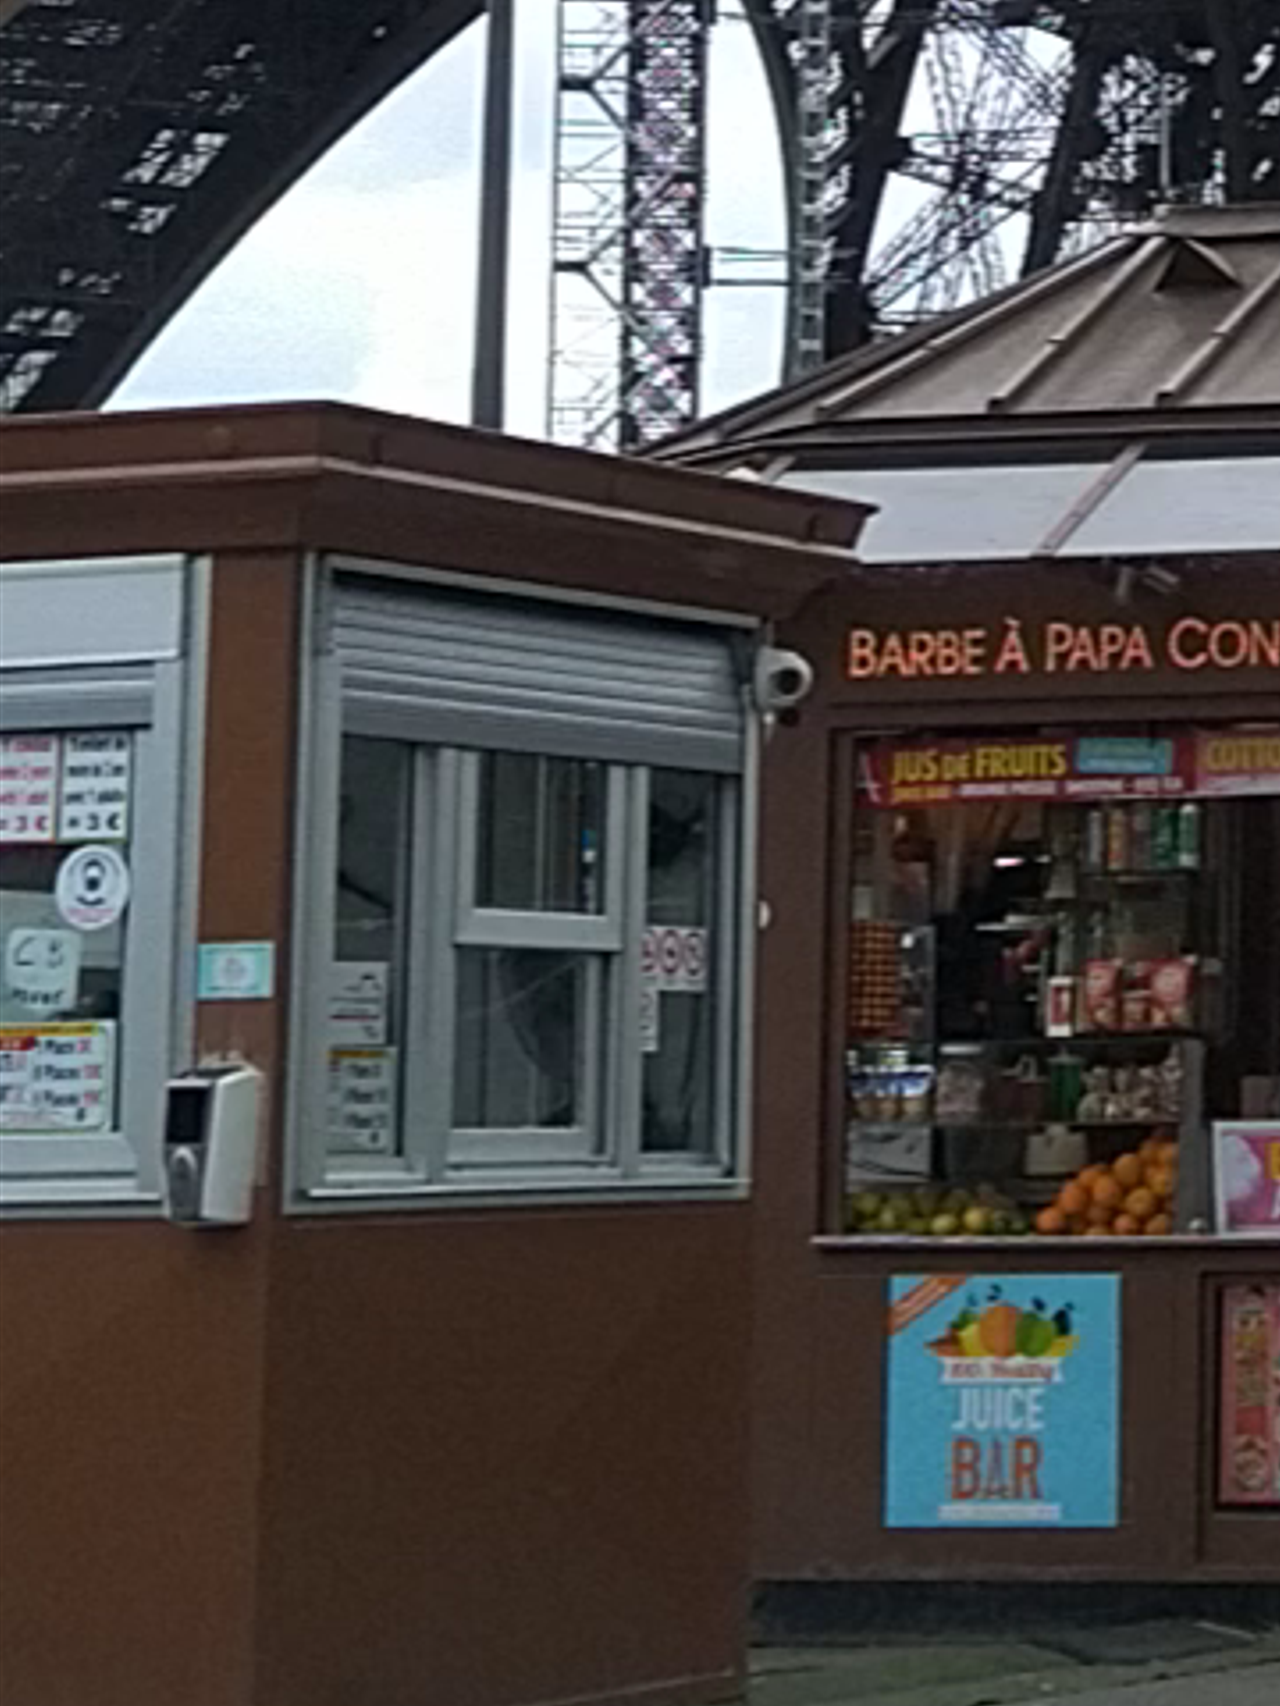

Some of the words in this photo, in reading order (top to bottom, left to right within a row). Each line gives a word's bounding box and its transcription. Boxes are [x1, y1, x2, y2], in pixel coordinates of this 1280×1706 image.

[848, 629, 987, 677] BARBE
[995, 617, 1030, 673] À
[1045, 622, 1153, 672] PAPA
[893, 749, 938, 784] JUS
[974, 744, 1067, 777] FRUITS
[950, 1387, 1046, 1431] JUICE
[948, 1436, 1045, 1501] BAR
